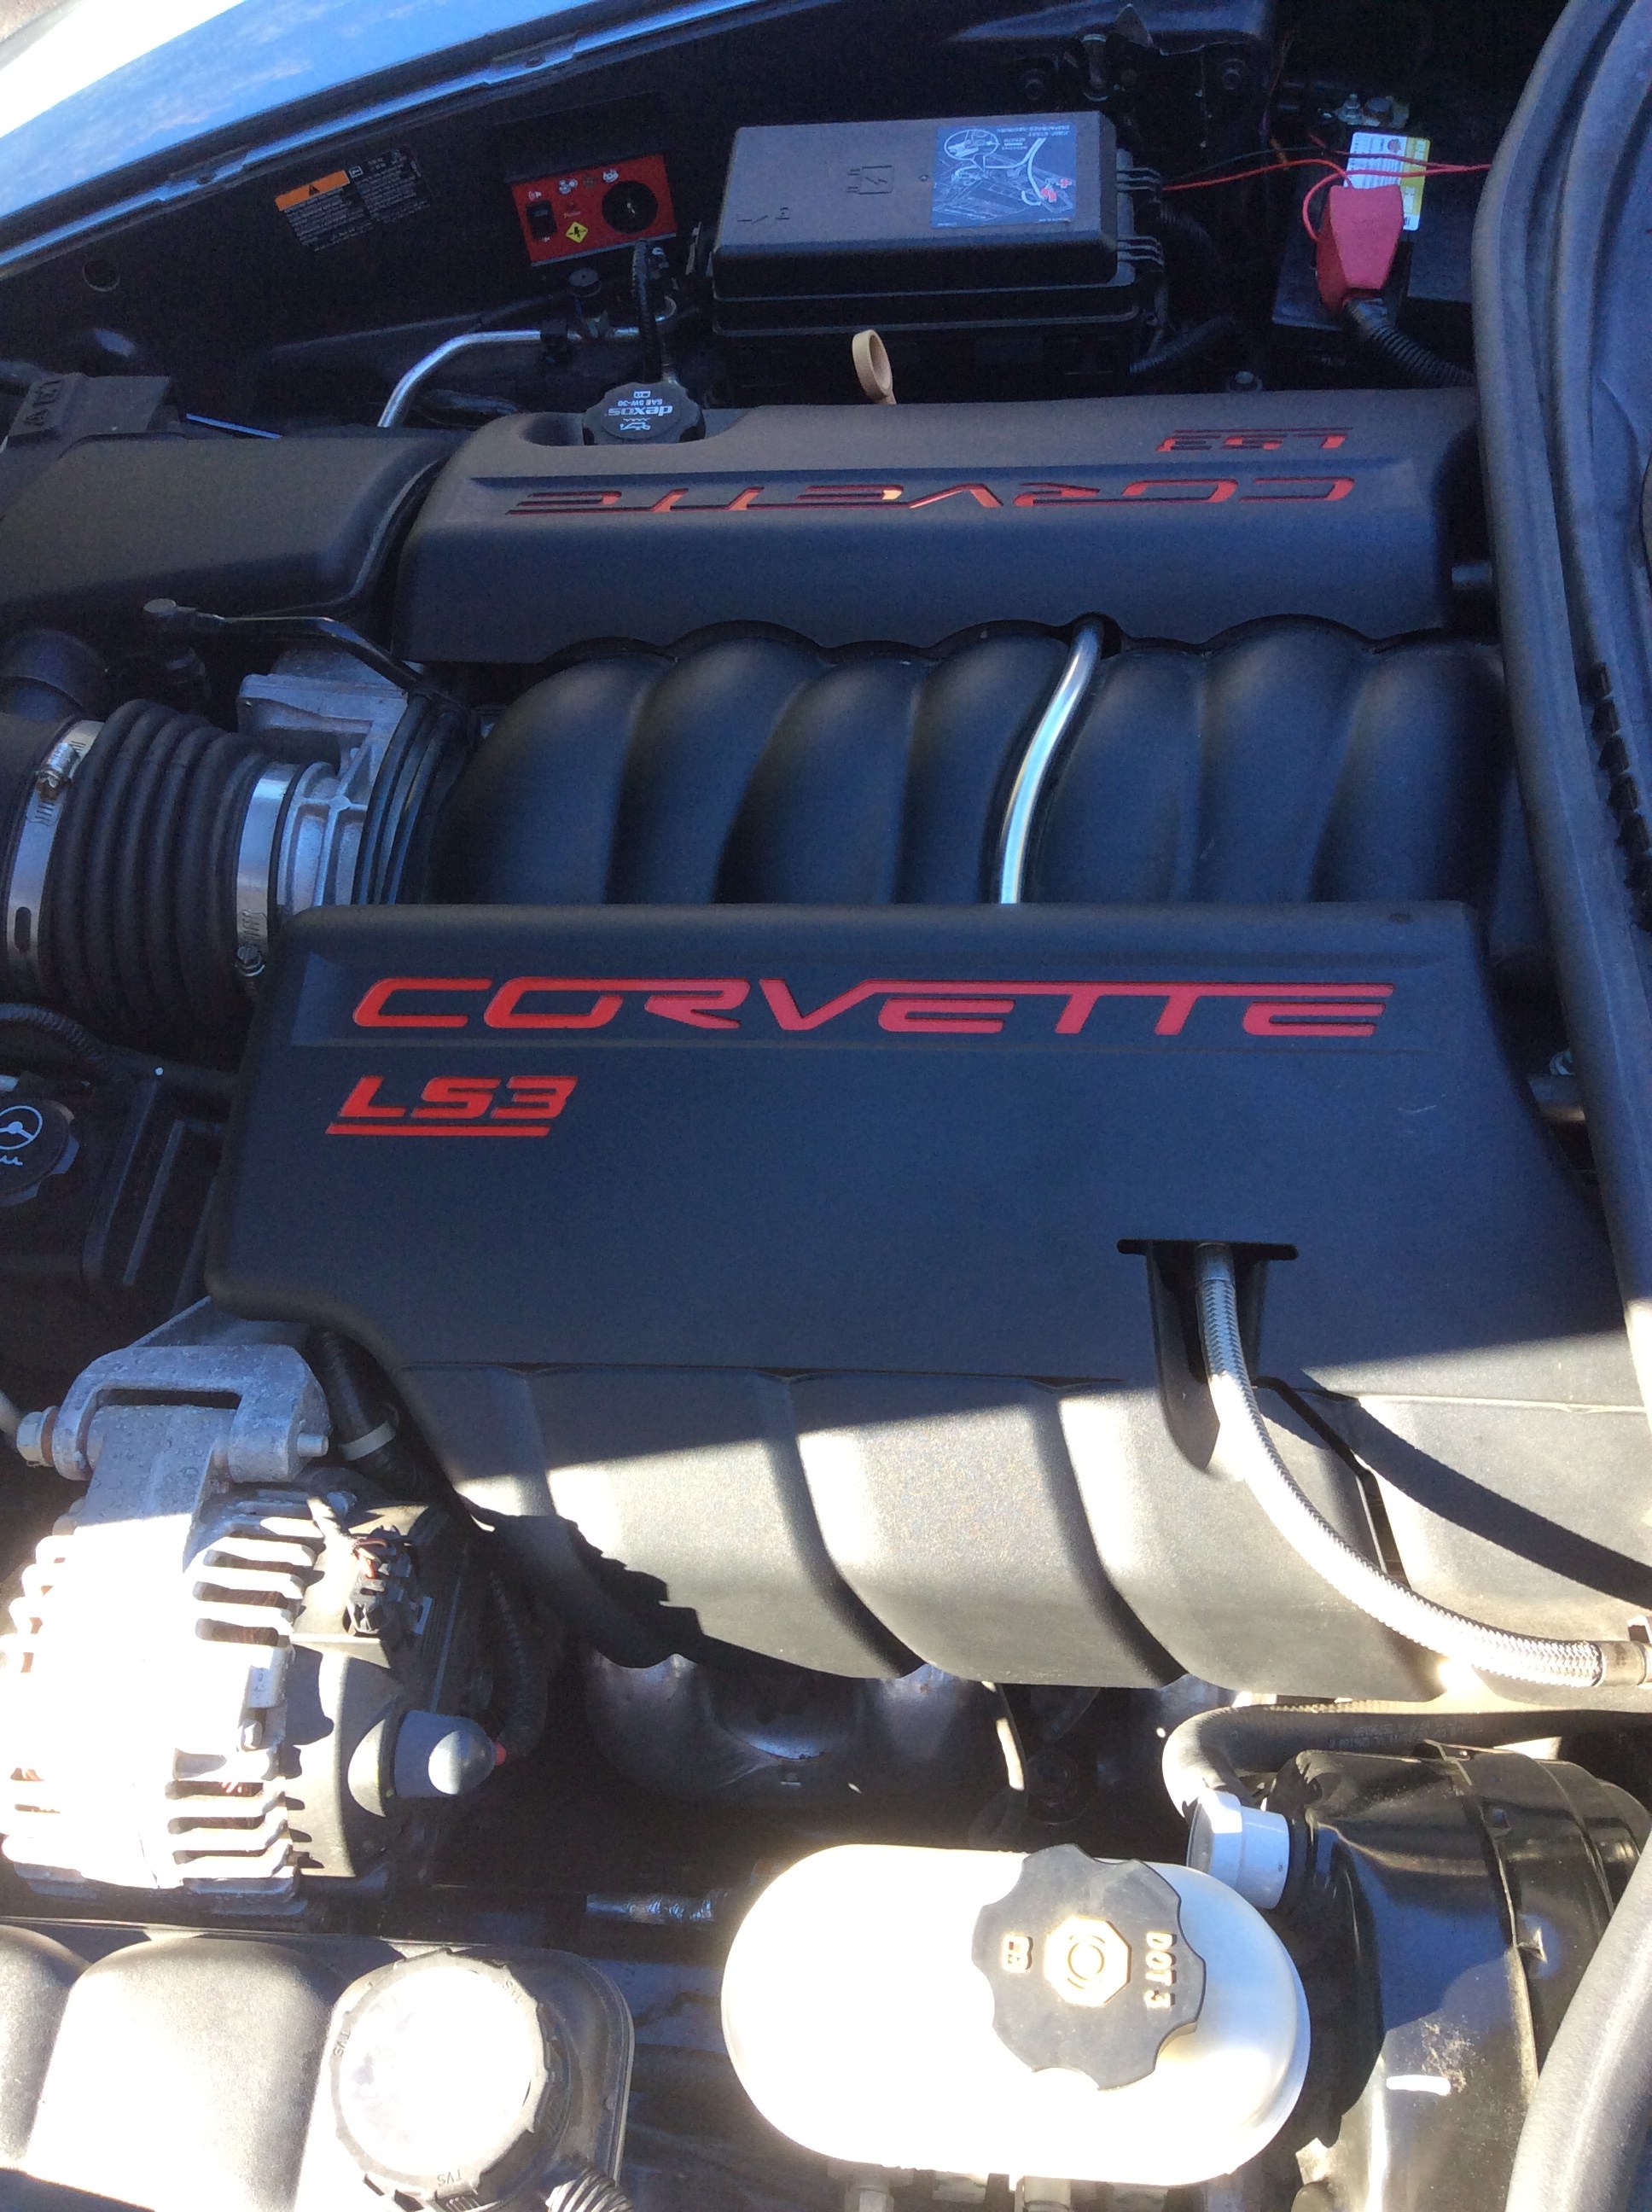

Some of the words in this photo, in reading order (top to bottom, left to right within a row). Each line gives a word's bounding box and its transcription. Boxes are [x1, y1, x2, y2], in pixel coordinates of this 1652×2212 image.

[608, 405, 673, 416] dexos
[505, 474, 1355, 515] CORVETTE
[352, 976, 1395, 1036] CORVETTE
[325, 1075, 578, 1137] LS3
[1145, 1931, 1178, 1987] DOT
[1143, 1989, 1176, 2009] 3
